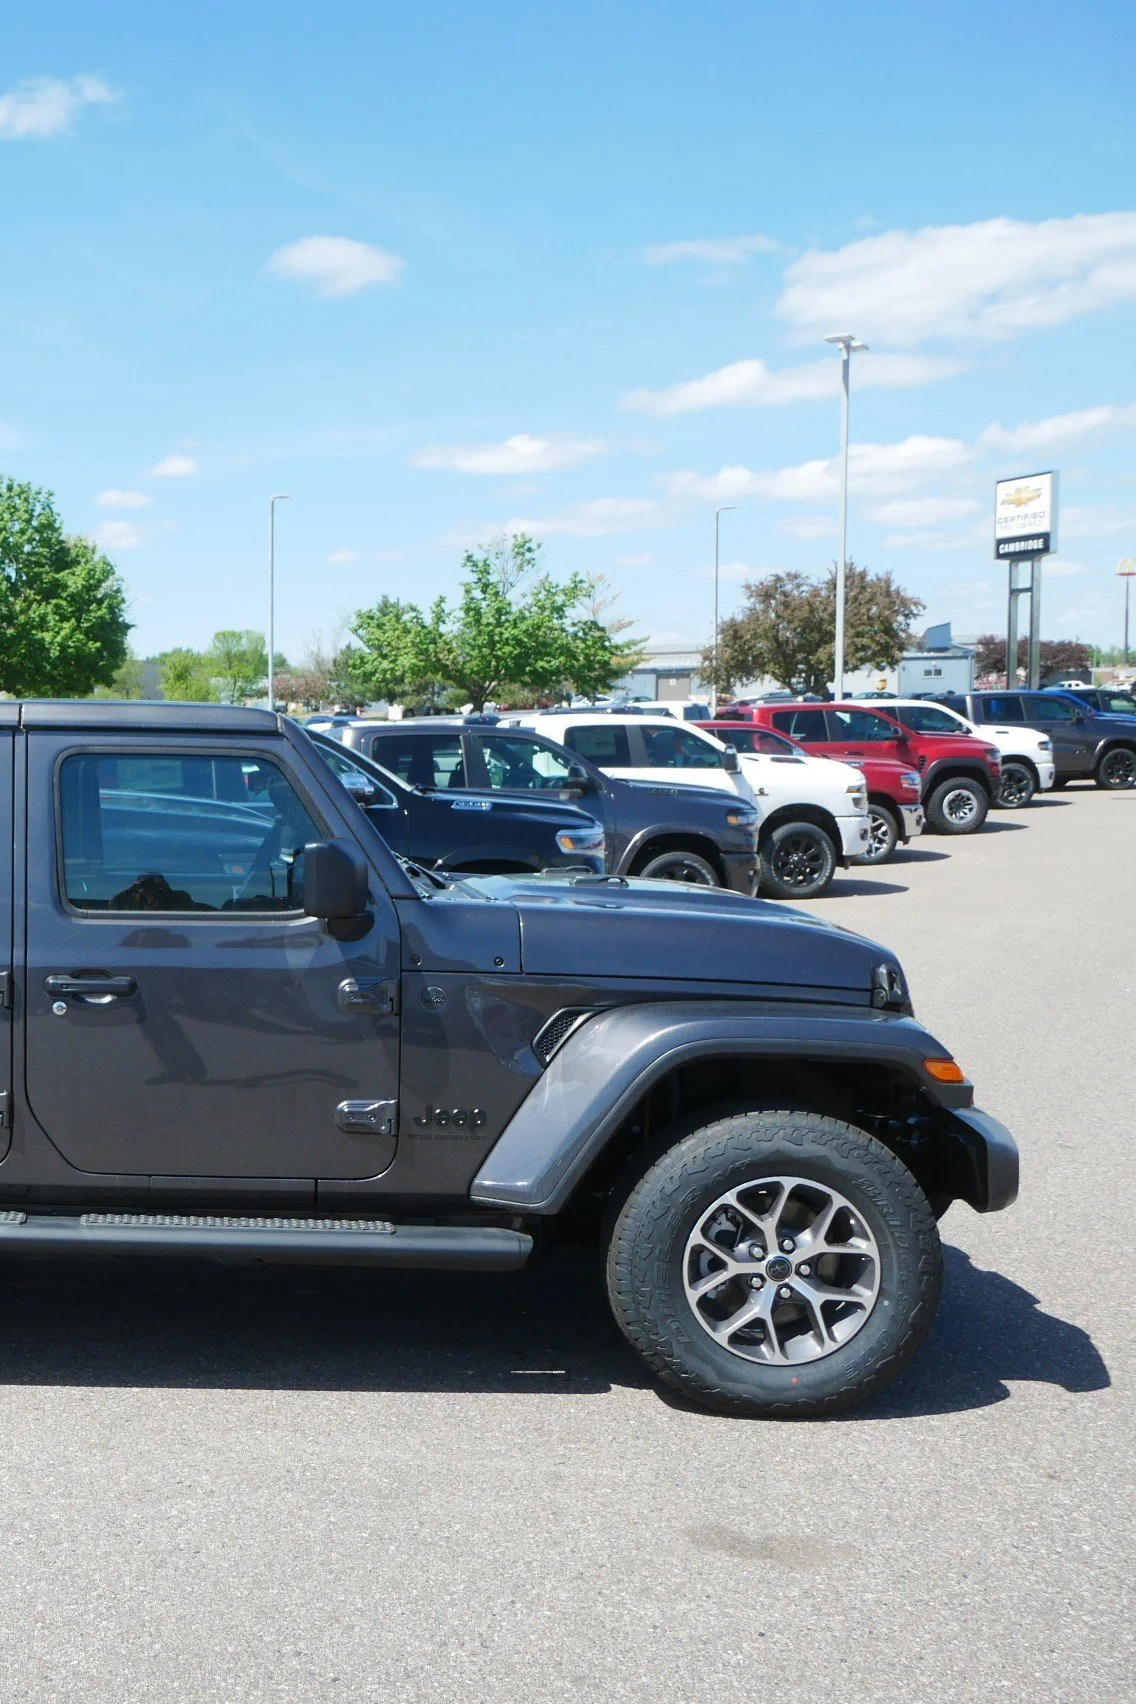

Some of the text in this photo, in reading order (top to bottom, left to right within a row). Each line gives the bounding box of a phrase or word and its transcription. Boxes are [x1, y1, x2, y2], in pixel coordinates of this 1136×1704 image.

[997, 511, 1046, 524] CERTIFIED
[998, 538, 1044, 554] CAMBRIDGE
[413, 1104, 488, 1132] Jeep
[843, 1178, 910, 1378] BRIDGESTONE
